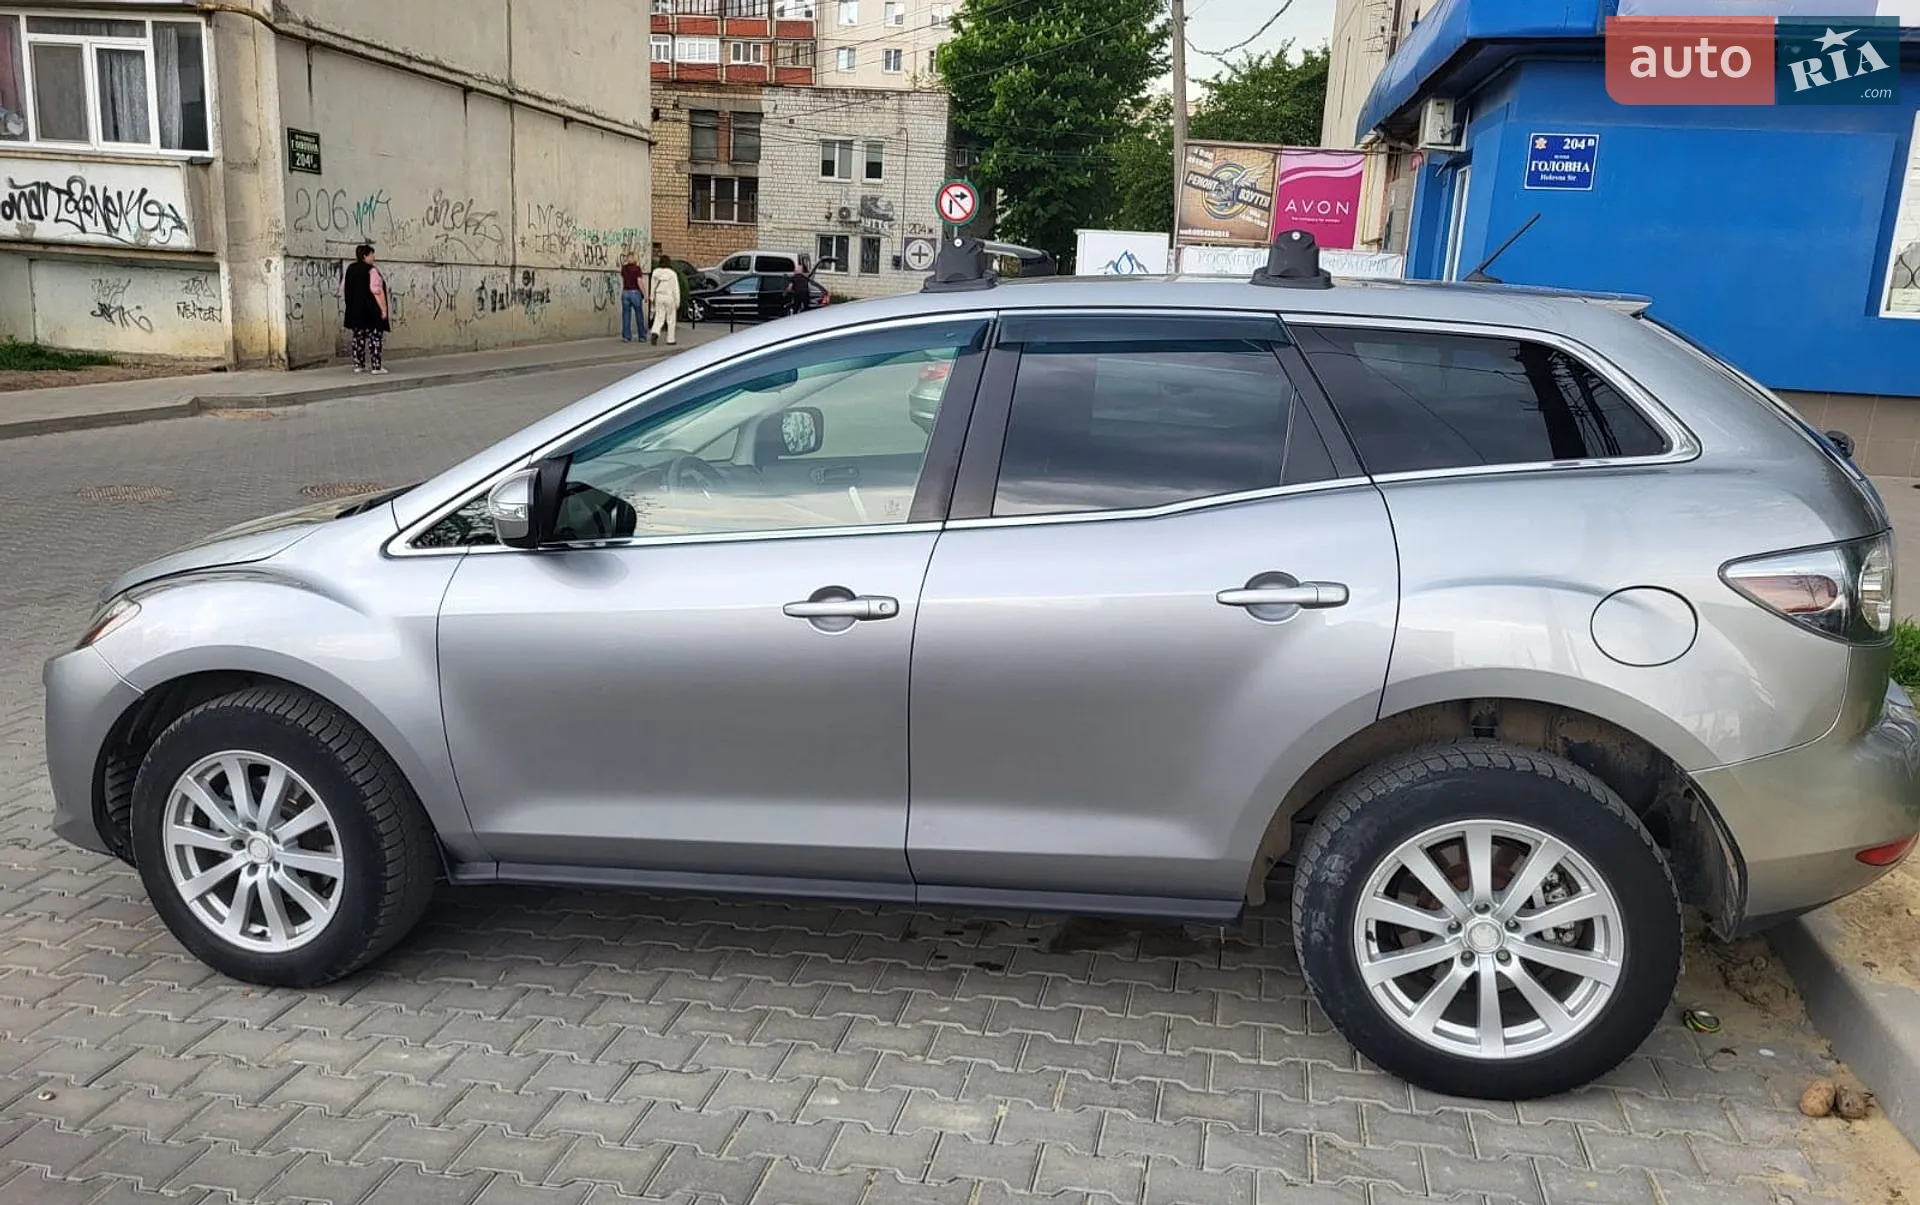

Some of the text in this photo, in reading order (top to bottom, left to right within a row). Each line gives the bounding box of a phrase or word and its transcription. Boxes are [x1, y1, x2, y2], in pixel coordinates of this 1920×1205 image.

[1531, 160, 1590, 173] ГОЛОВНА
[1187, 173, 1219, 191] РЕМОНТ
[1239, 188, 1270, 208] ВЗУТТЯ
[1284, 199, 1349, 215] AVON
[294, 187, 349, 232] 206
